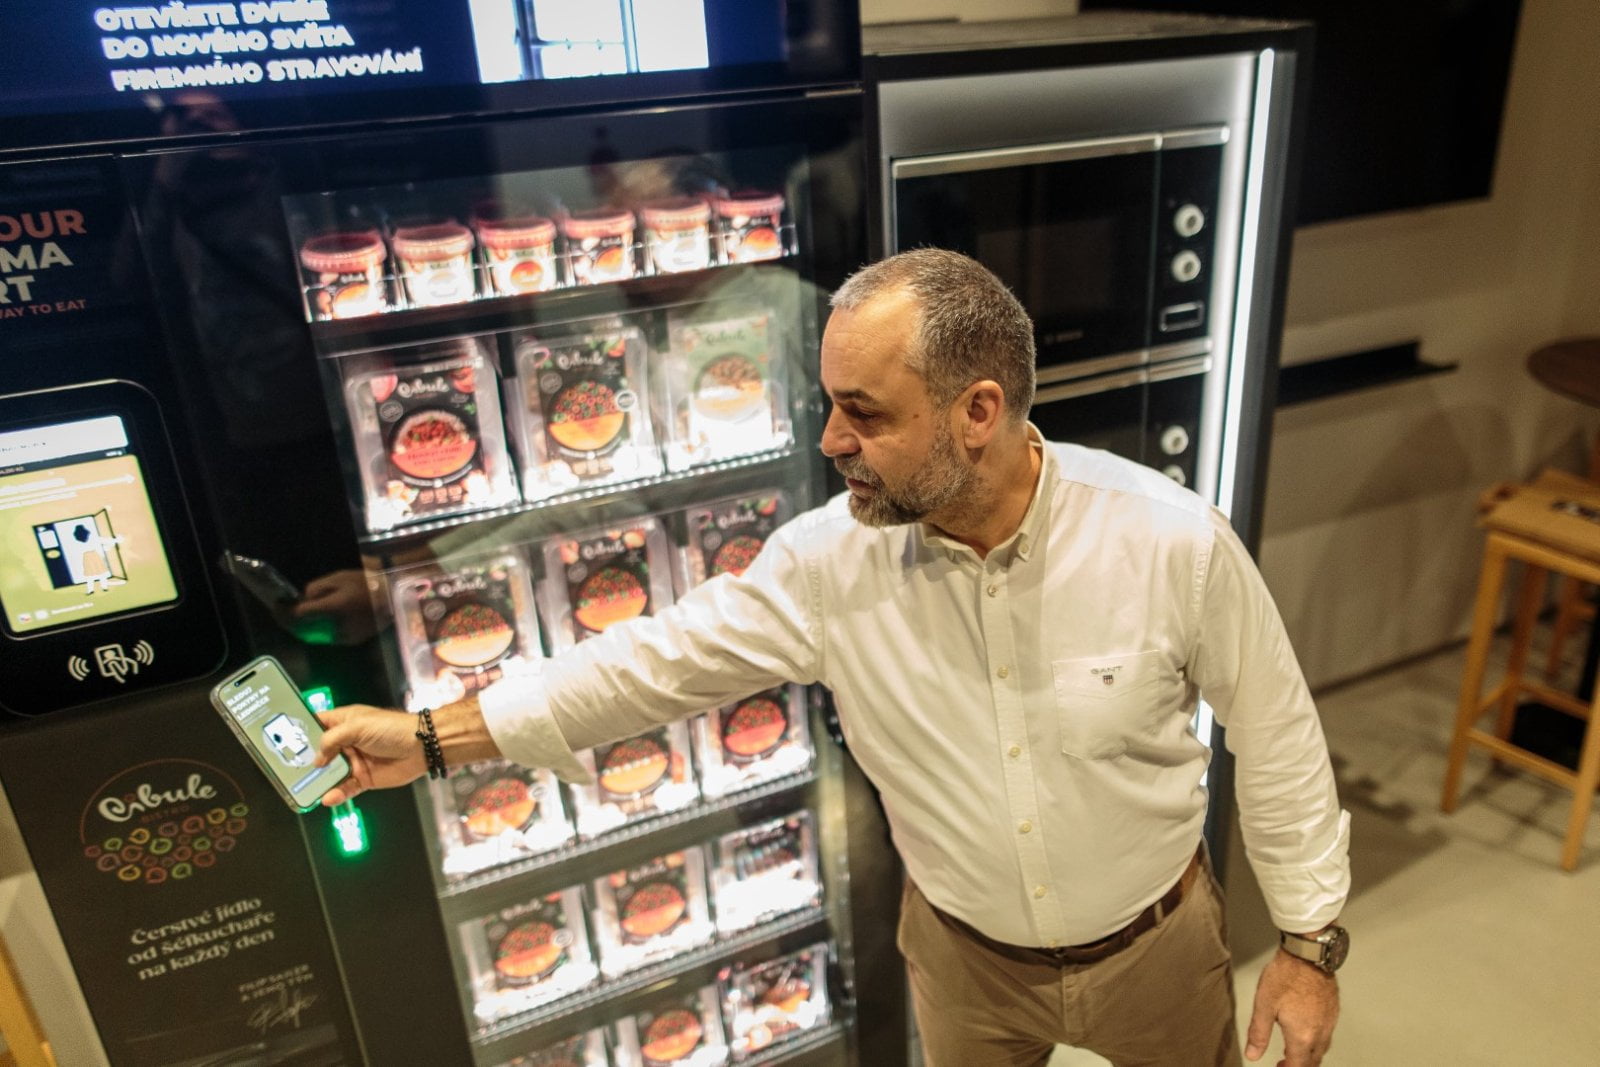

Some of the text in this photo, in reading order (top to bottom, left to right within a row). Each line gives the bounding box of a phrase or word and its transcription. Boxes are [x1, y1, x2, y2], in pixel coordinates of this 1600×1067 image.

[94, 0, 330, 31] OTEVŘETE DVEŘE
[102, 22, 355, 60] DO NOVÉHO SVĚTA
[111, 46, 424, 92] FIREMNÍHO STRAVOVÁNÍ
[0, 299, 87, 319] AY TO EAT
[1090, 665, 1123, 675] GANT
[98, 773, 218, 822] Cibule
[127, 911, 276, 965] od šéfkuchaře
[131, 898, 262, 945] Čerstvé jídlo
[138, 929, 275, 981] na každý den
